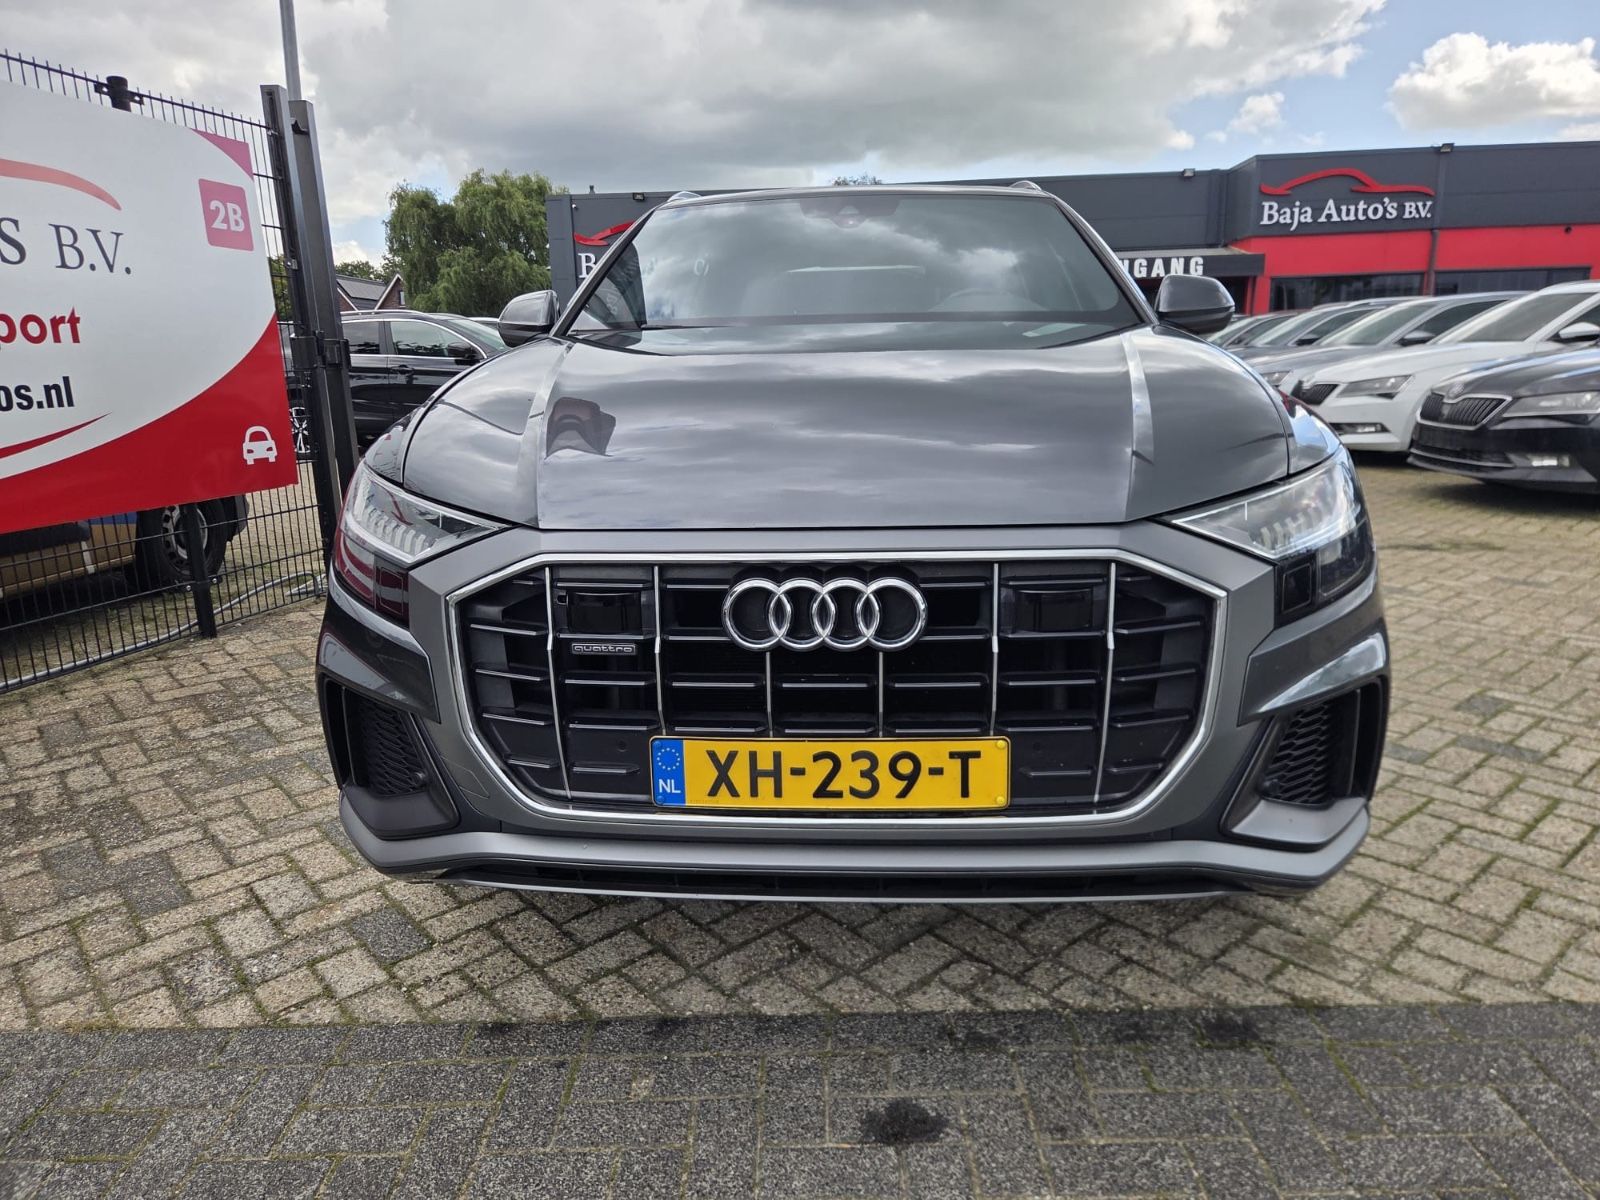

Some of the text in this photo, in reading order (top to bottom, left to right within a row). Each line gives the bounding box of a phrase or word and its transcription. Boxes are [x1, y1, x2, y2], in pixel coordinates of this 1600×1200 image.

[209, 199, 245, 232] 2B
[1260, 197, 1433, 231] Baja Auto's B.V.
[48, 223, 132, 275] B.V.
[574, 644, 633, 654] quattro
[658, 778, 682, 794] NL
[705, 749, 982, 799] XH-239-T
